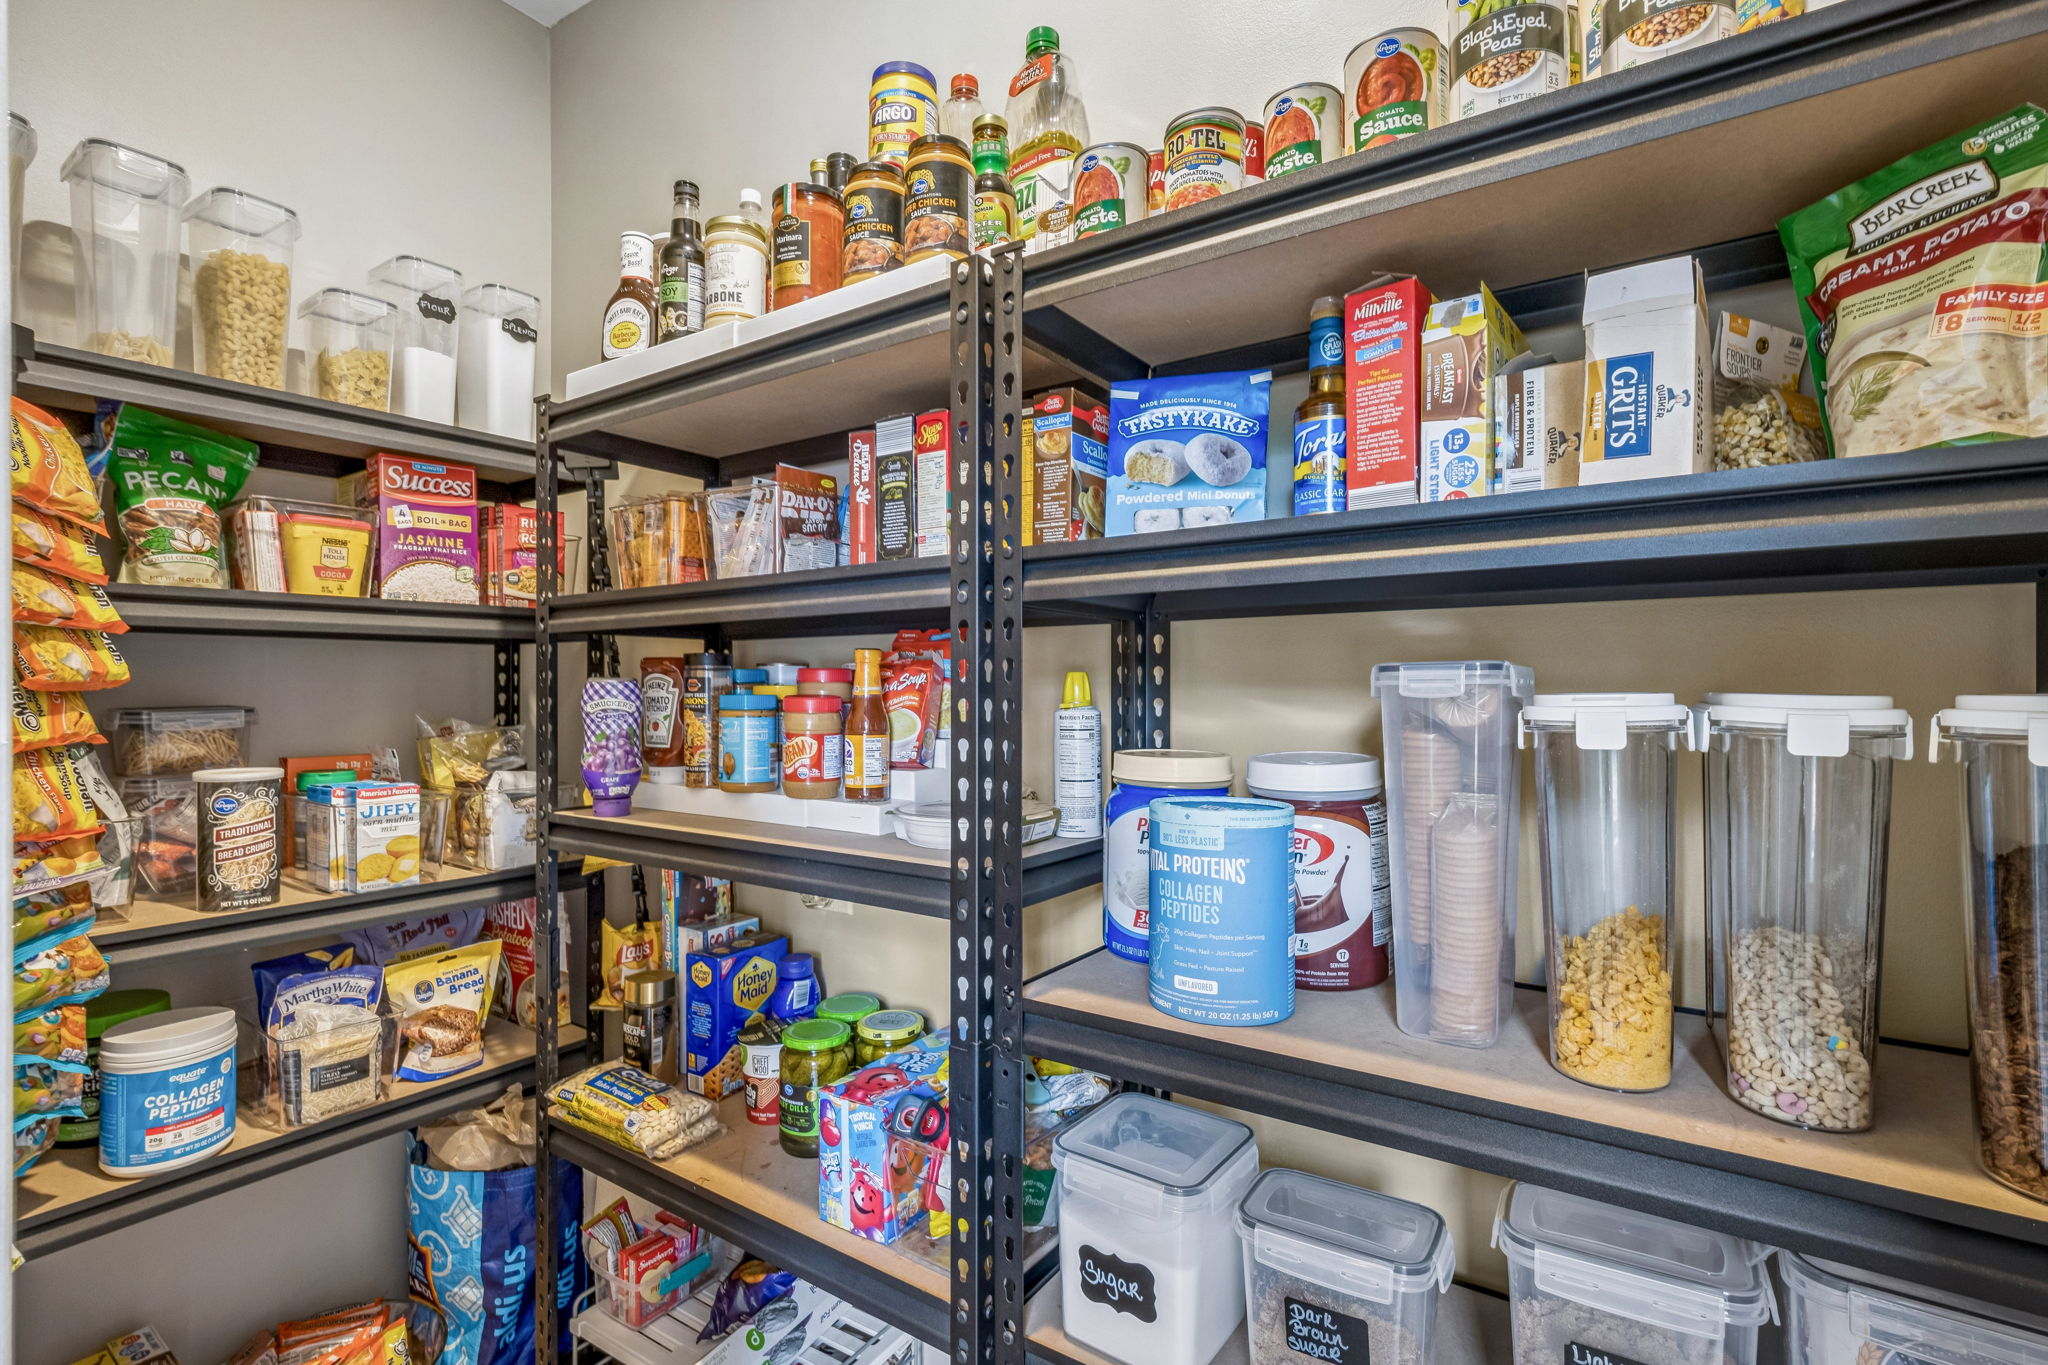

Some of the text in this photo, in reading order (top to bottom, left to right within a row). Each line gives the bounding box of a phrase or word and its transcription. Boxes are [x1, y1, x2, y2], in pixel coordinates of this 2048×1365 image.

[1376, 39, 1400, 58] Kroger
[1480, 34, 1522, 57] Peas
[1274, 97, 1293, 116] Kroger
[1498, 94, 1511, 104] NET
[874, 103, 912, 125] ARGO
[1376, 106, 1405, 119] TOMATO
[1360, 112, 1423, 143] Sauce
[1986, 113, 2037, 143] MINUTES
[886, 132, 911, 142] STARCH
[1082, 155, 1099, 172] Kroger
[1266, 150, 1315, 178] Paste
[1272, 149, 1296, 165] TOMATO
[917, 198, 956, 208] CHICKEN
[1080, 206, 1101, 216] TOMATO
[910, 207, 932, 218] SAUCE
[1048, 209, 1069, 221] CHICKEN
[1075, 209, 1119, 231] Paste
[857, 223, 893, 234] CHICKEN
[1858, 192, 1988, 254] COUNTRY KITCHENS
[777, 234, 802, 245] Marinara
[849, 231, 870, 240] SAUCE
[1820, 200, 2030, 302] CREAMY POTATO
[1883, 250, 1941, 276] SOUP MIX
[662, 287, 678, 296] SOY
[1842, 256, 1975, 312] Slow-cooked homestyle flavor crafted
[1854, 279, 1946, 314] delicate herbs savory
[1858, 289, 1924, 318] classic creamy
[1944, 290, 2045, 308] FAMILY SIZE
[1354, 297, 1404, 321] Millville
[2015, 312, 2042, 324] 1/2
[1945, 313, 1963, 332] 8
[1726, 349, 1762, 372] FRONTIER
[1442, 352, 1455, 404] BREAKFAST
[1726, 361, 1752, 379] SOUPS
[1140, 398, 1222, 409] MADE DELICIOUSLY SINCE
[1609, 366, 1639, 448] GRITS
[1656, 384, 1665, 418] QUAKER
[1526, 380, 1535, 456] FIBER PROTEIN
[1592, 392, 1601, 431] BUTTER
[1036, 415, 1069, 427] Scalloped
[1125, 410, 1253, 435] TASTYKAKE
[918, 422, 943, 445] Stove
[927, 433, 939, 447] Top
[1430, 440, 1439, 469] LIGHT
[1547, 427, 1558, 464] QUAKER
[420, 465, 443, 473] MINUTE
[853, 440, 862, 486] Deluxe
[861, 444, 870, 482] HELPER
[385, 465, 472, 498] Success
[1464, 461, 1475, 484] 25%
[1116, 489, 1256, 506] Powdered Mini Donuts
[399, 509, 406, 518] 4
[417, 516, 468, 528] BOIL BAG
[394, 544, 431, 553] FRAGRANT
[398, 533, 464, 549] JASMINE
[174, 555, 207, 563] GEORGIA
[648, 683, 665, 691] HEINZ
[589, 701, 634, 710] SMUCKER'S
[646, 697, 670, 705] TOMATO
[26, 751, 51, 792] Chicken
[360, 789, 391, 797] America's
[215, 800, 237, 810] Kroger
[360, 803, 416, 819] JIFFY
[219, 819, 272, 839] TRADITIONAL
[363, 815, 414, 826] corn muffin
[1174, 833, 1219, 848] LESS PLASTIC
[218, 839, 273, 861] BREAD CRUMBS
[1173, 856, 1246, 885] PROTEINS
[1159, 878, 1223, 905] COLLAGEN
[1160, 902, 1220, 925] PEPTIDES
[402, 925, 425, 946] Red
[1183, 929, 1265, 942] Collagen Peptides Serving
[621, 943, 650, 963] Lay's
[1230, 949, 1253, 958] Support
[694, 967, 710, 977] Honey
[1173, 959, 1244, 973] Grass Pasture Raised
[435, 968, 479, 988] Banana
[449, 977, 485, 995] Bread
[695, 973, 710, 983] Maid
[738, 969, 773, 991] Honey
[1177, 979, 1213, 991] UNFLAVORED
[740, 983, 768, 1002] Maid
[1178, 1006, 1273, 1023] NET WT 20 OZ (1.25 567
[625, 1035, 639, 1043] GOLD
[753, 1057, 767, 1066] CHEF
[753, 1065, 768, 1075] WOO
[169, 1067, 207, 1083] equate
[144, 1077, 224, 1108] COLLAGEN
[149, 1090, 221, 1120] PEPTIDES
[849, 1112, 876, 1122] TROPICAL
[853, 1122, 873, 1132] PUNCH
[494, 1244, 526, 1350] aldi.us
